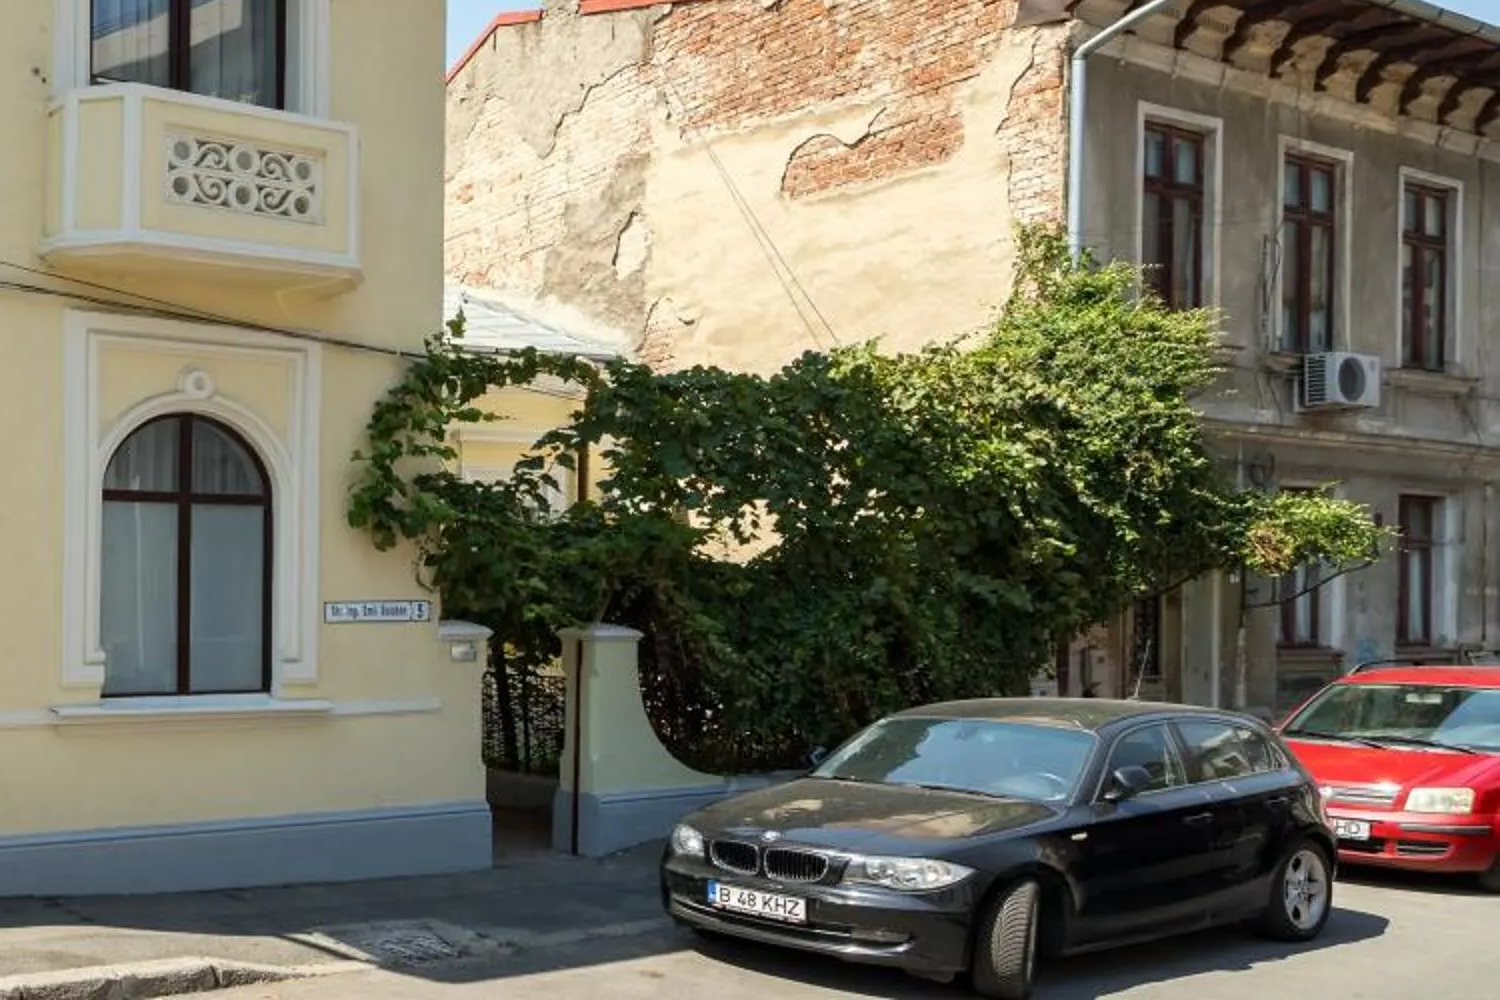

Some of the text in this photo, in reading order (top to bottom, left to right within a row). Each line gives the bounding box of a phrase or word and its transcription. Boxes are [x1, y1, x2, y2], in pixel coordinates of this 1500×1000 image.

[720, 887, 800, 916] B 48 KHZ
